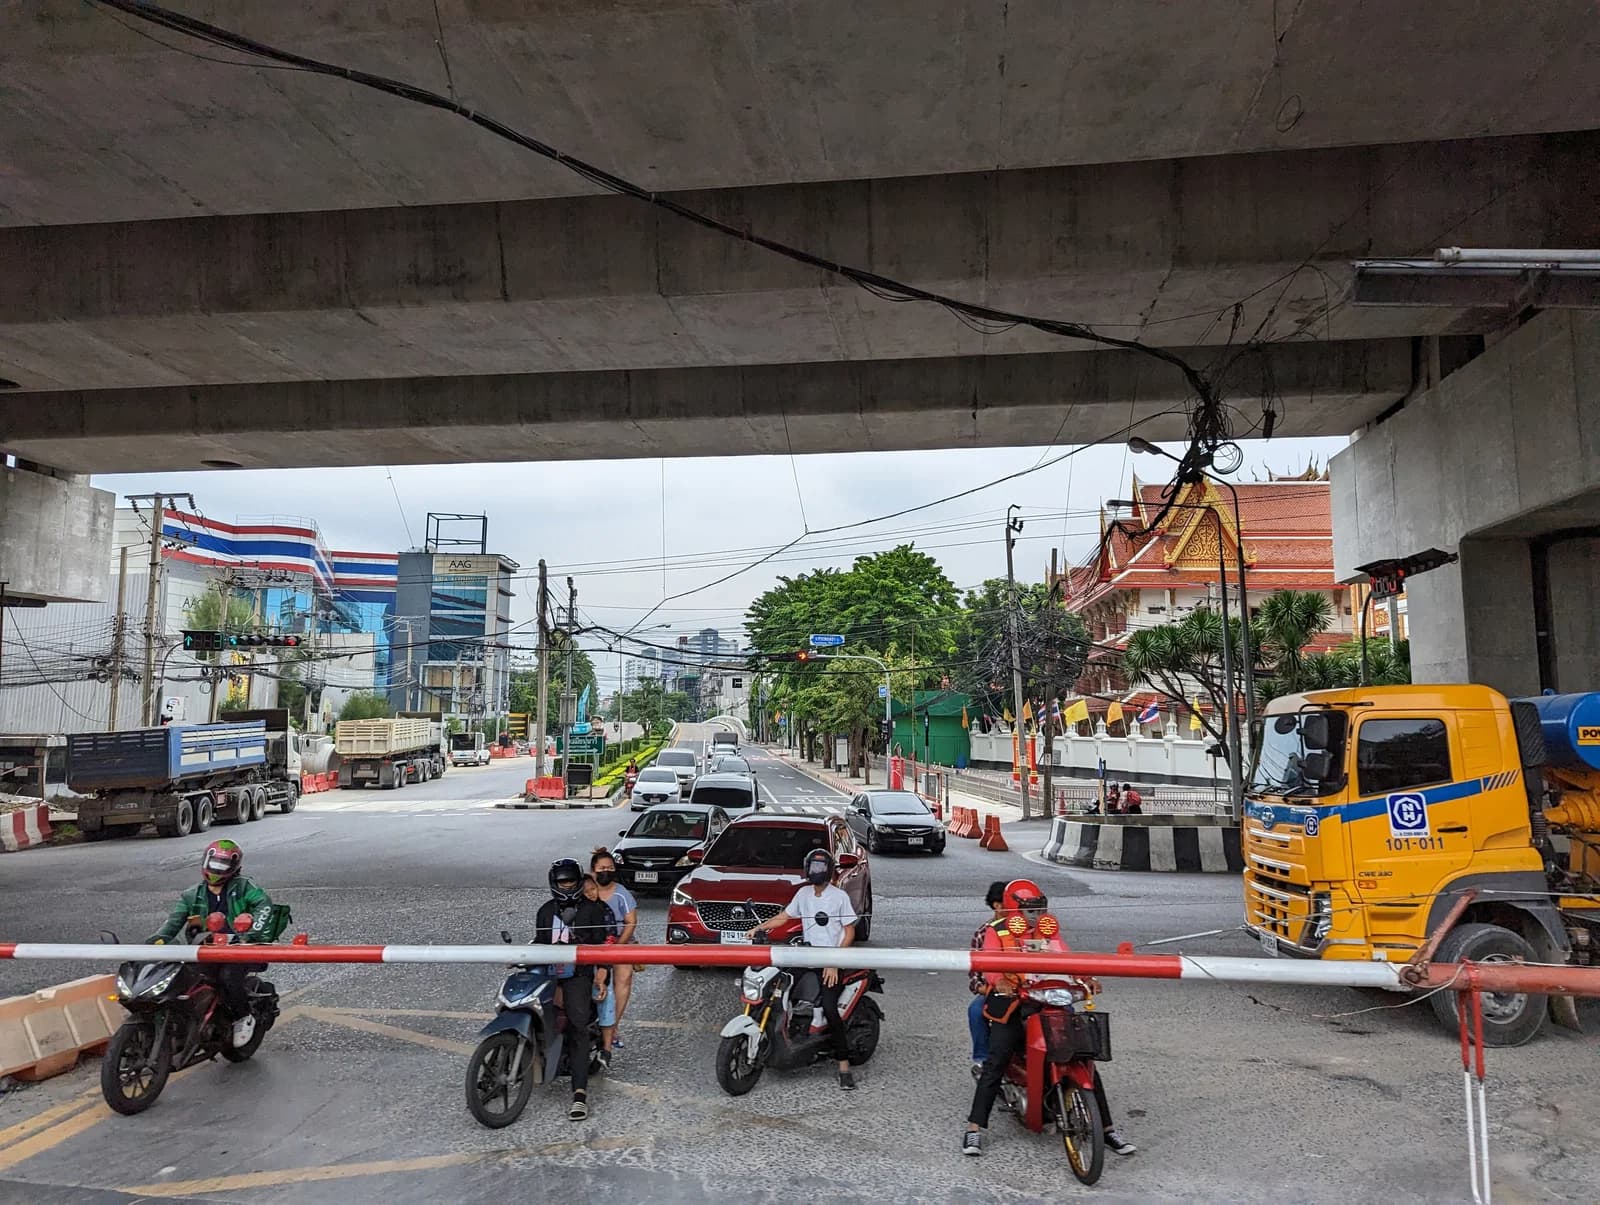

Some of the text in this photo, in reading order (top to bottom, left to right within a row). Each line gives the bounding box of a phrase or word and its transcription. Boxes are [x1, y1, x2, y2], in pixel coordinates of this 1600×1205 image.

[449, 560, 472, 568] AAG
[1583, 729, 1600, 739] PO
[1385, 837, 1444, 851] 101-011
[252, 905, 272, 931] Grab
